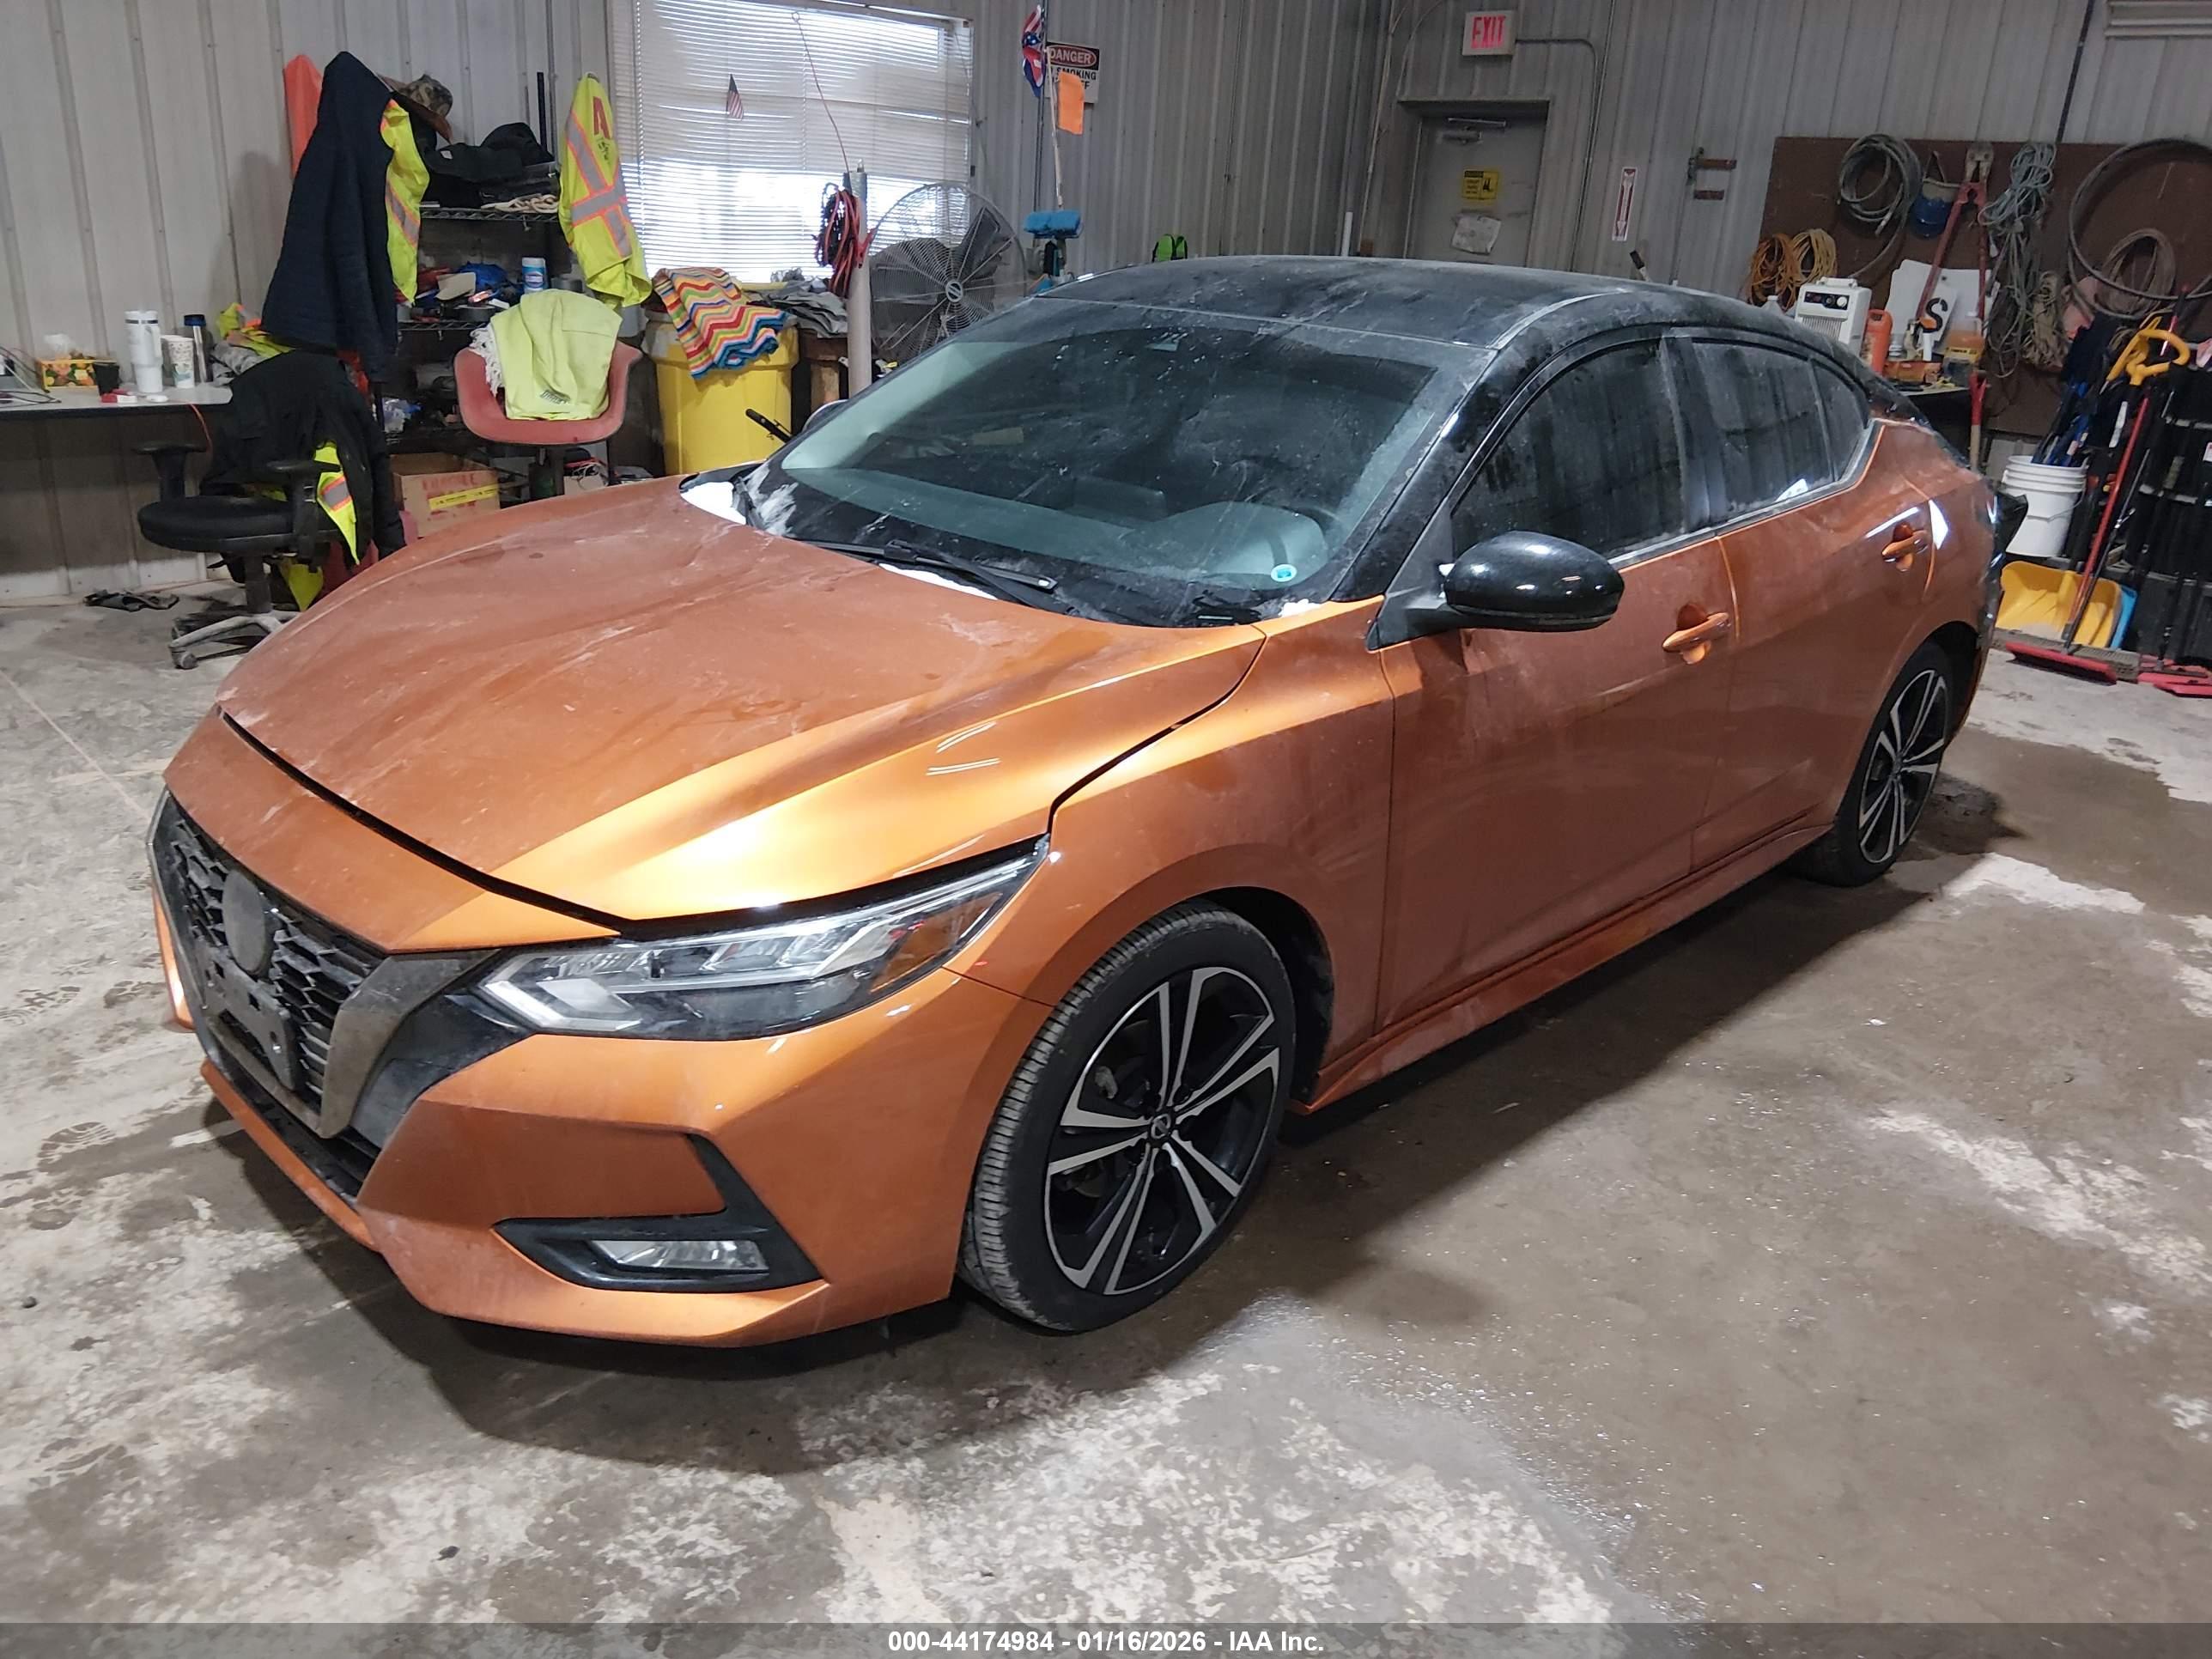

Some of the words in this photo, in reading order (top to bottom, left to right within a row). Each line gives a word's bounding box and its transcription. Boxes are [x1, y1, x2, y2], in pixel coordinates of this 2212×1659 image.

[1471, 14, 1506, 48] EXIT
[1049, 47, 1091, 64] DANGER
[1919, 298, 1948, 333] S
